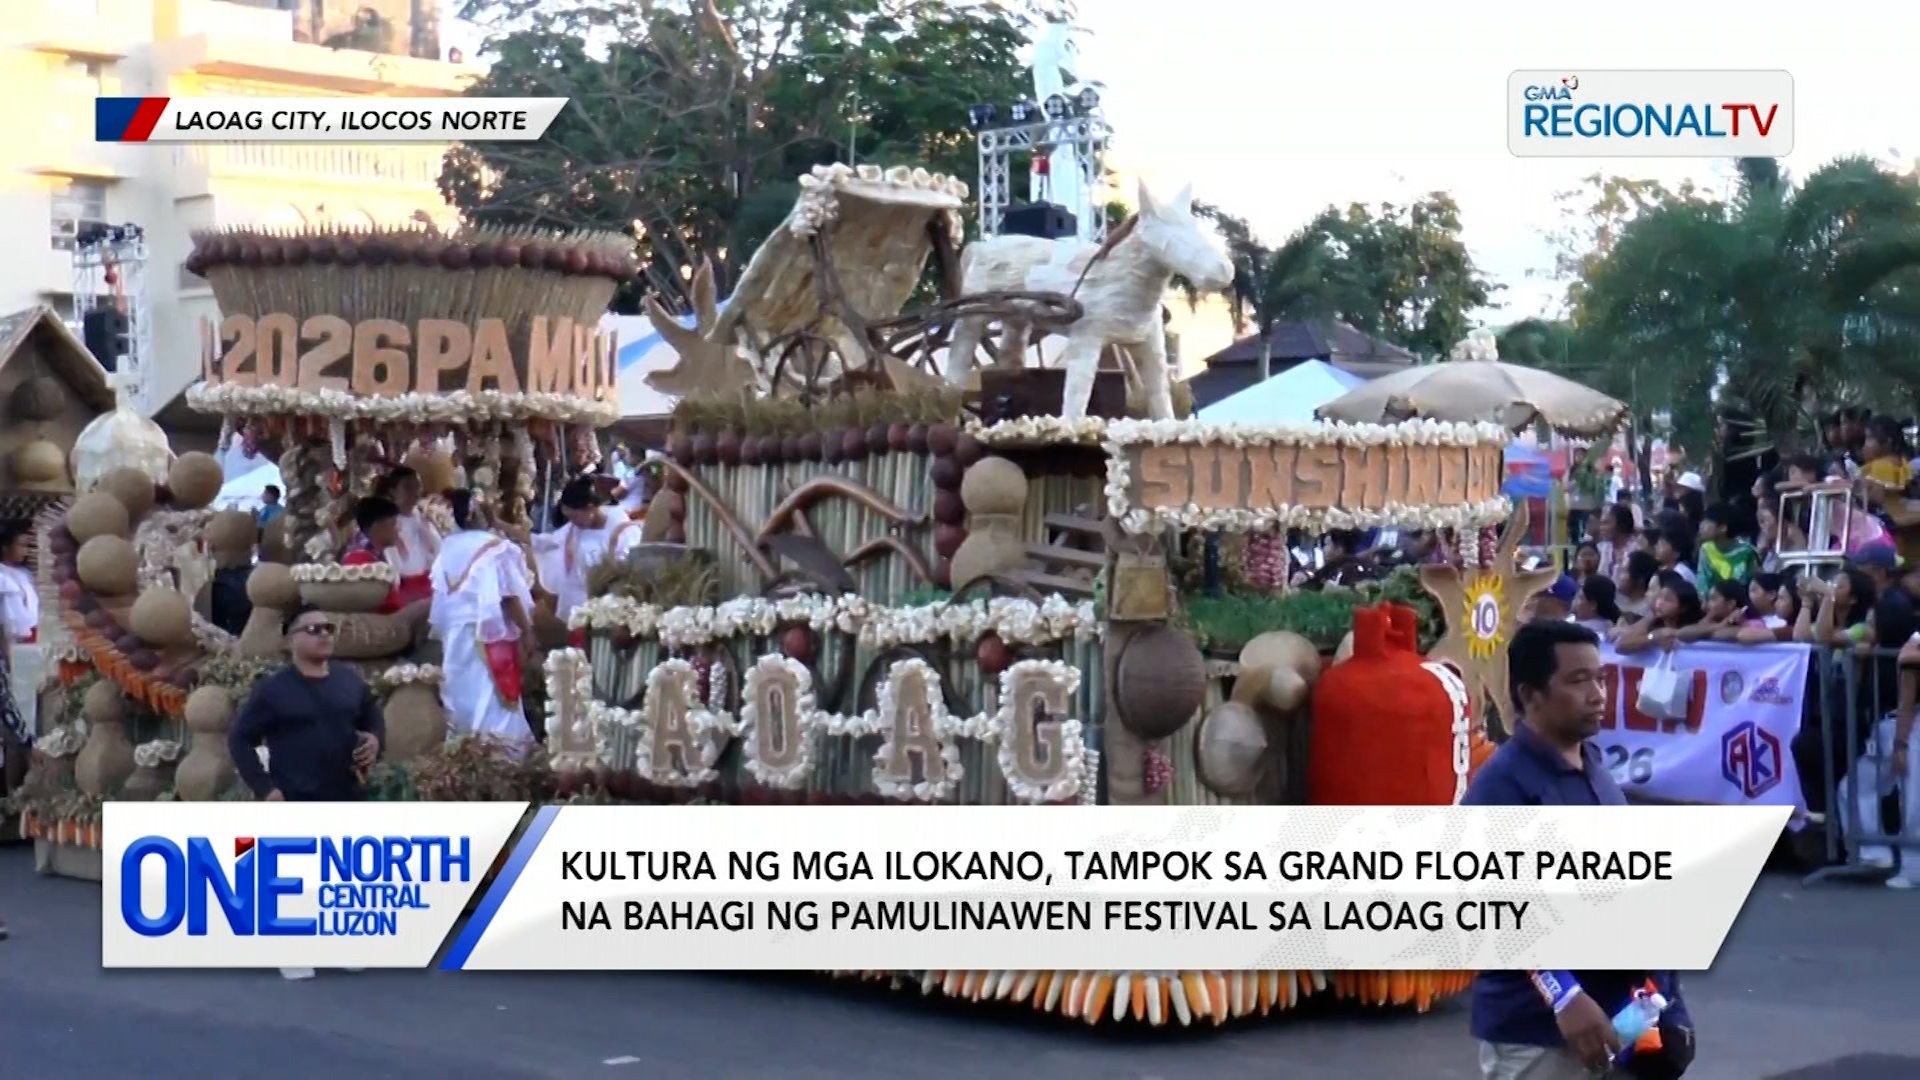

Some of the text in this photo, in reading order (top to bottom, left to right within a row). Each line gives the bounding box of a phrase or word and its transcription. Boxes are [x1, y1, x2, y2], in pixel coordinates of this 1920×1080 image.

[222, 313, 411, 394] 2026
[1140, 446, 1465, 509] SUNSHINE
[1476, 601, 1496, 634] 10
[547, 656, 1078, 788] LAOAG
